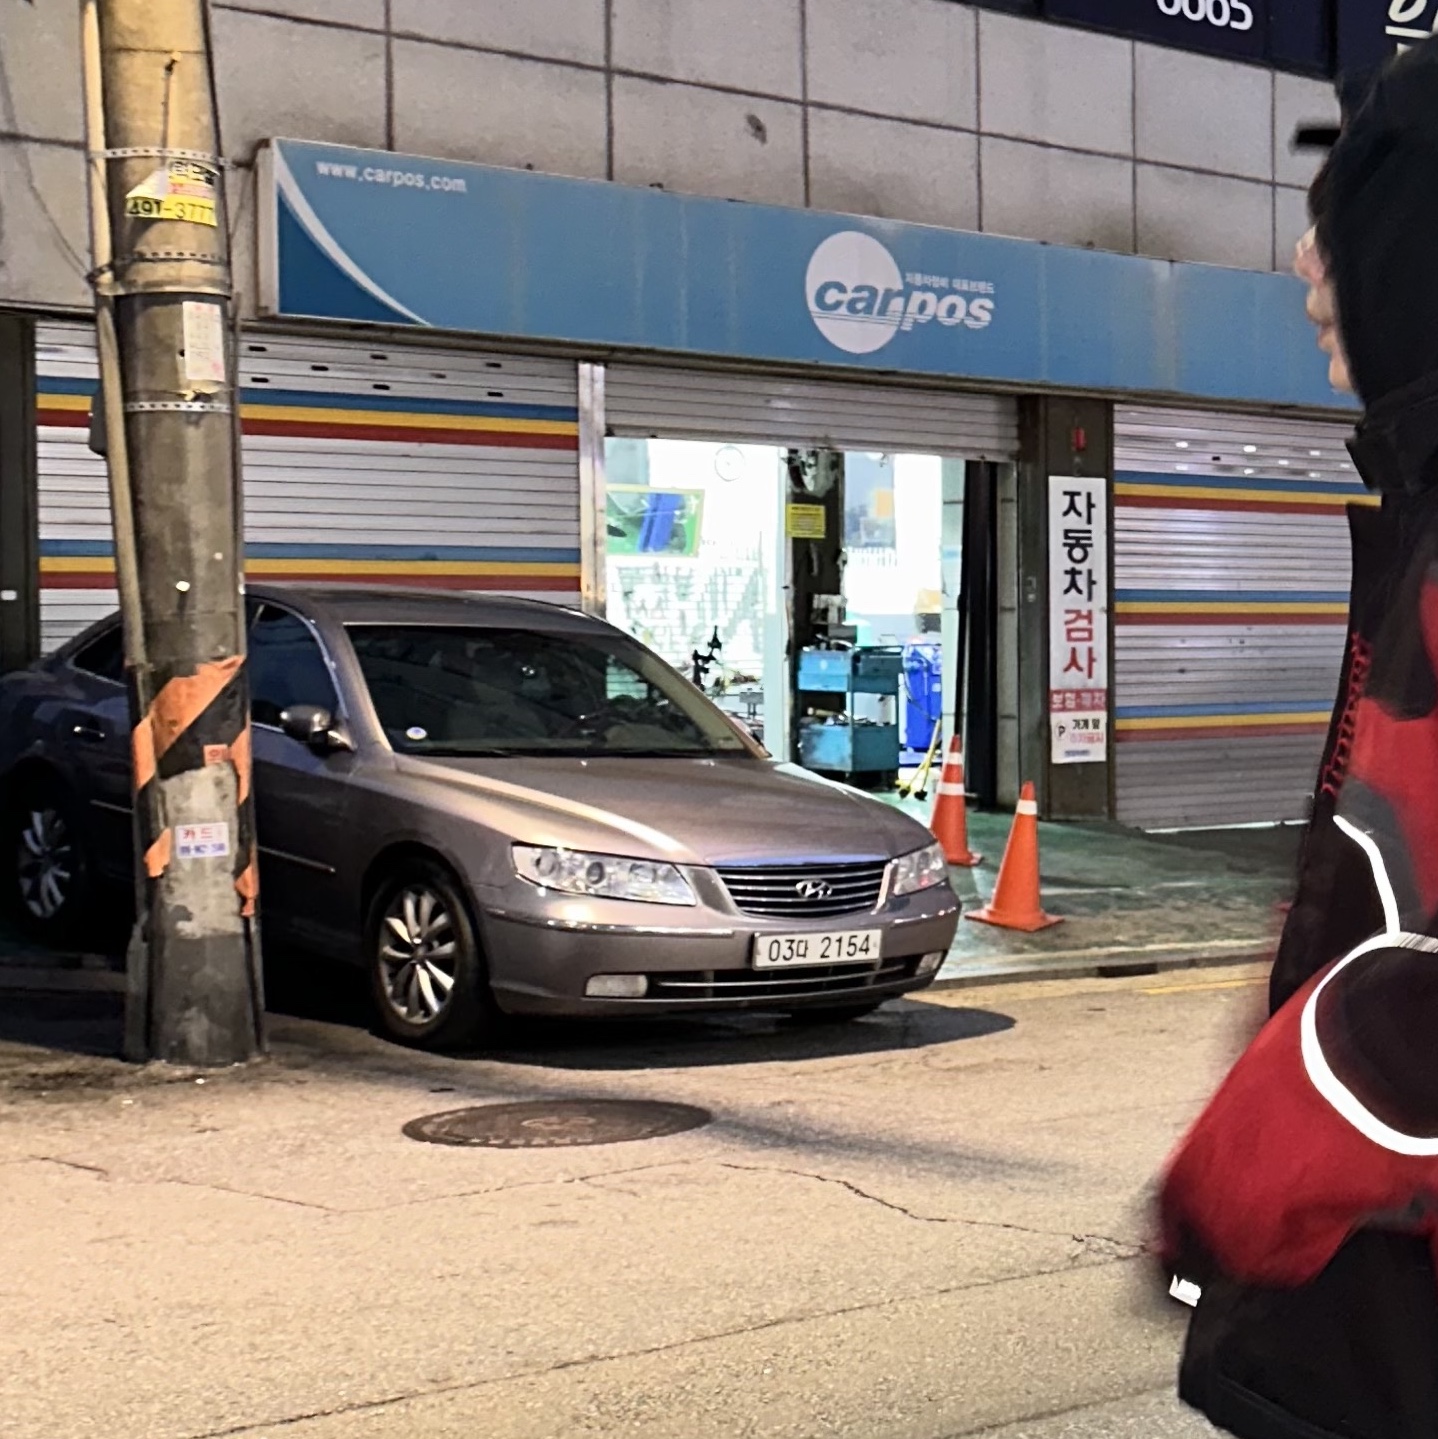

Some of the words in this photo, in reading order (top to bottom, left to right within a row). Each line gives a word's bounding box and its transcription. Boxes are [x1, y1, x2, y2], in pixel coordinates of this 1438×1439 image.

[315, 161, 468, 193] www.carpos.com
[814, 280, 995, 332] carpos
[768, 939, 809, 962] 03다
[820, 934, 870, 959] 2154
